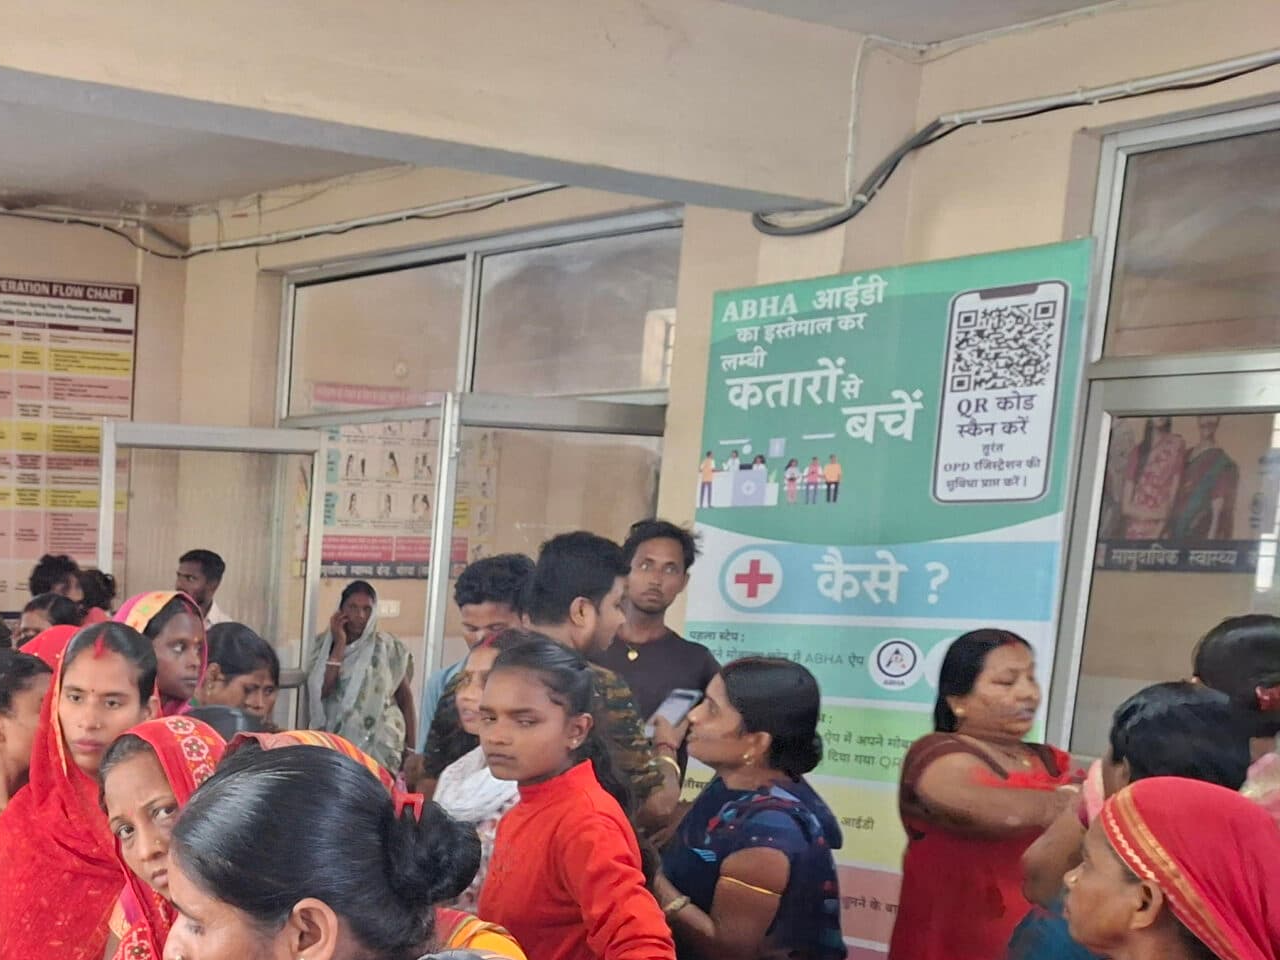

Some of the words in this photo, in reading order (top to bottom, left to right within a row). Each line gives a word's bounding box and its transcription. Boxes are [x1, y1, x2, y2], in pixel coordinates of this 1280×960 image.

[53, 284, 84, 298] FLOW
[86, 287, 124, 301] CHART
[721, 293, 798, 323] ABHA
[812, 274, 888, 312] आईडी
[736, 326, 761, 343] का
[763, 316, 834, 344] इस्तेमाल
[837, 312, 868, 331] कर
[725, 356, 846, 411] कतारों
[840, 373, 864, 400] से
[840, 388, 924, 443] बचें
[957, 398, 989, 419] QR
[995, 390, 1038, 411] कोड
[956, 418, 997, 438] स्कैन
[999, 416, 1030, 434] करें
[812, 546, 909, 604] कैसे
[925, 561, 950, 605] ?
